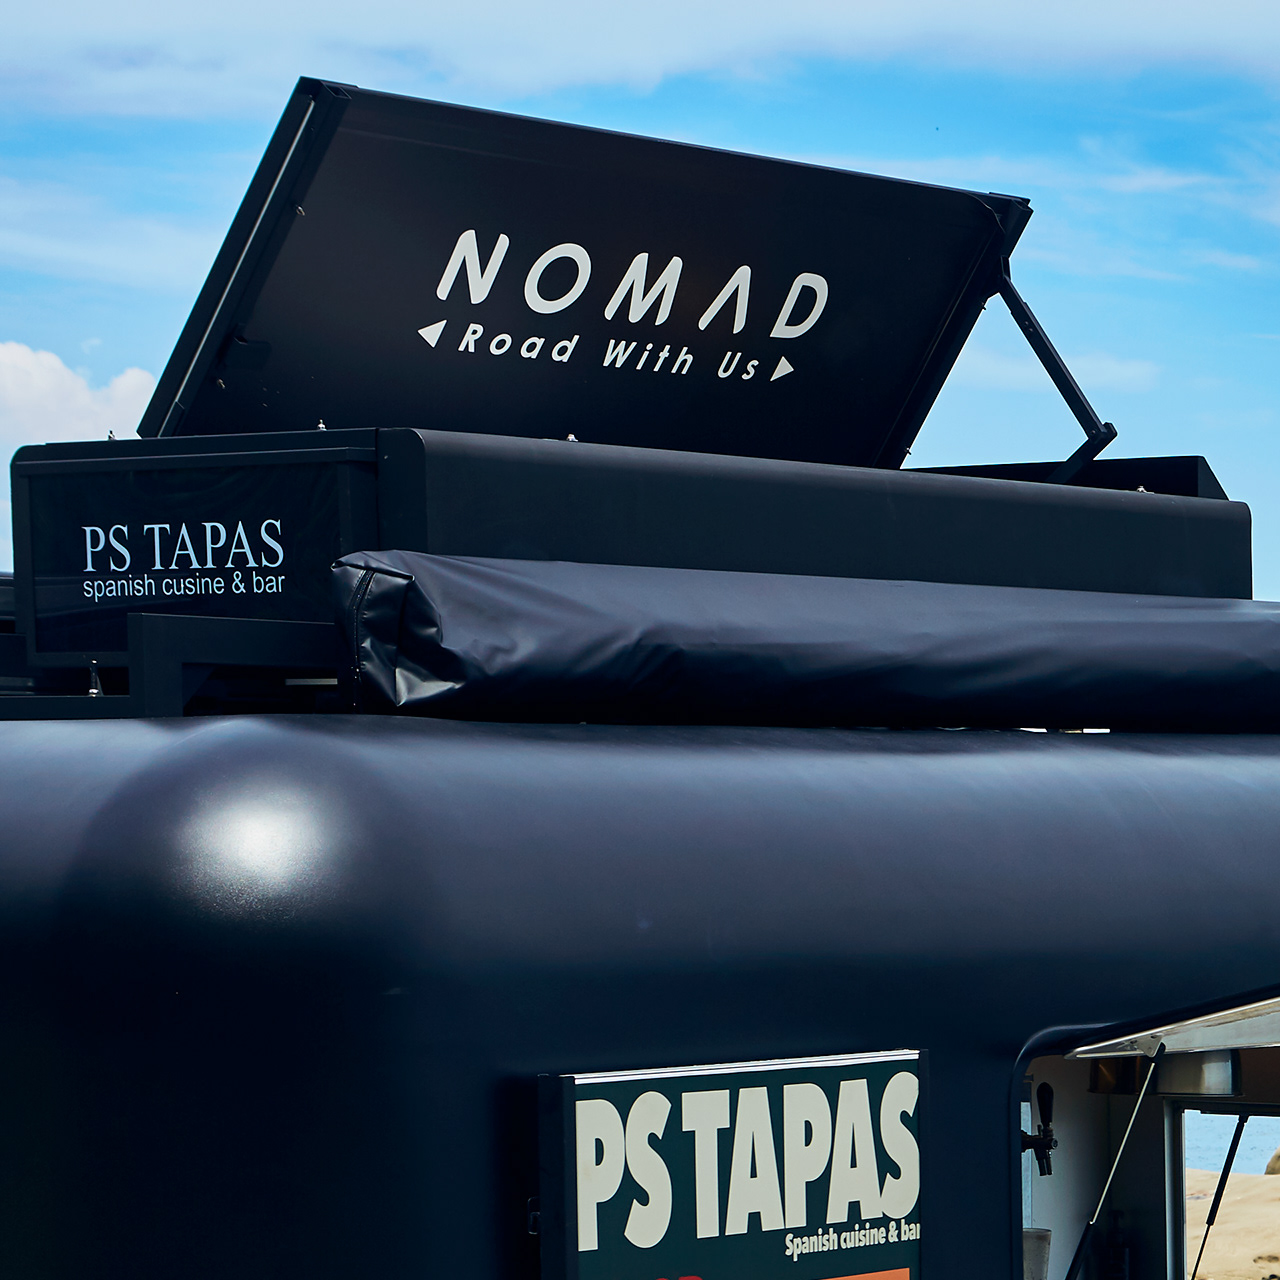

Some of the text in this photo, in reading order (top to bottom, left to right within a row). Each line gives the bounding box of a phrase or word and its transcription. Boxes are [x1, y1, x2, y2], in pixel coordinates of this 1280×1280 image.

[458, 323, 759, 380] Road With Us
[81, 519, 284, 572] PS TAPAS
[83, 571, 285, 602] spanish cusine & bar
[576, 1071, 920, 1252] PS TAPAS
[785, 1228, 838, 1262] Spanish
[840, 1223, 886, 1248] cuisine
[888, 1222, 899, 1242] &
